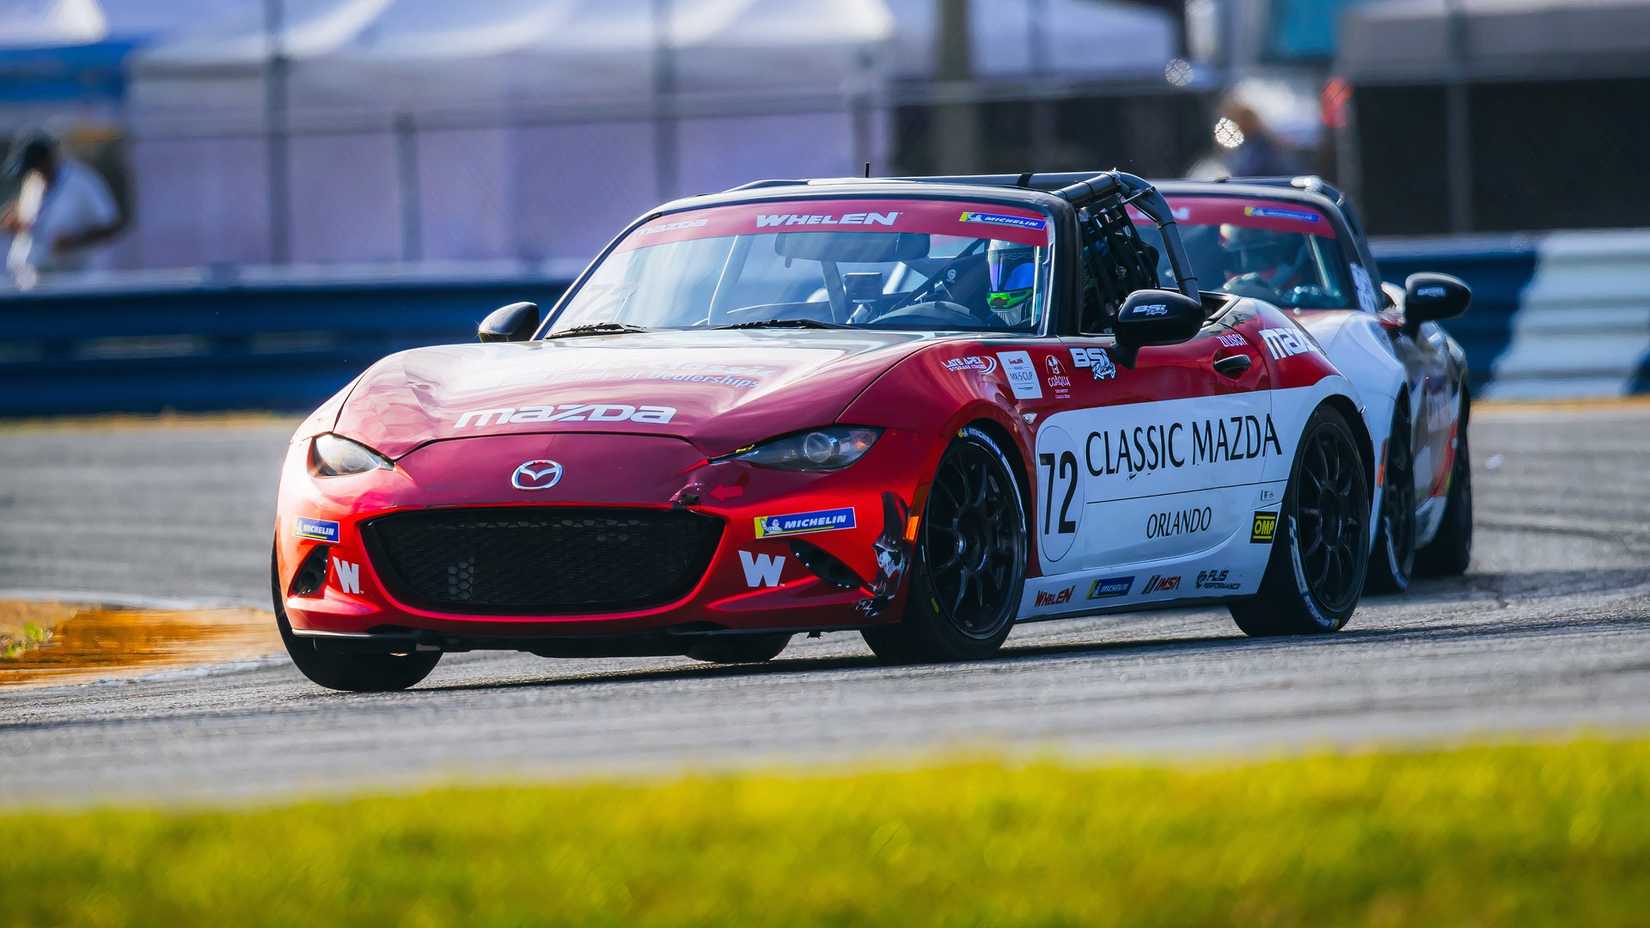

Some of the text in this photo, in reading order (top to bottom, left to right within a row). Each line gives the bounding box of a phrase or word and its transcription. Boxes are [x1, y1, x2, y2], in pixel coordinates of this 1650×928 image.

[755, 211, 899, 228] WHELEN
[984, 216, 1039, 227] MICHELIN
[453, 402, 678, 430] mazda
[1085, 413, 1283, 476] CLASSIC MAZDA
[1038, 450, 1079, 536] 72
[784, 514, 847, 530] MICHELIN
[1146, 506, 1213, 540] ORLANDO
[1254, 519, 1276, 536] OMP
